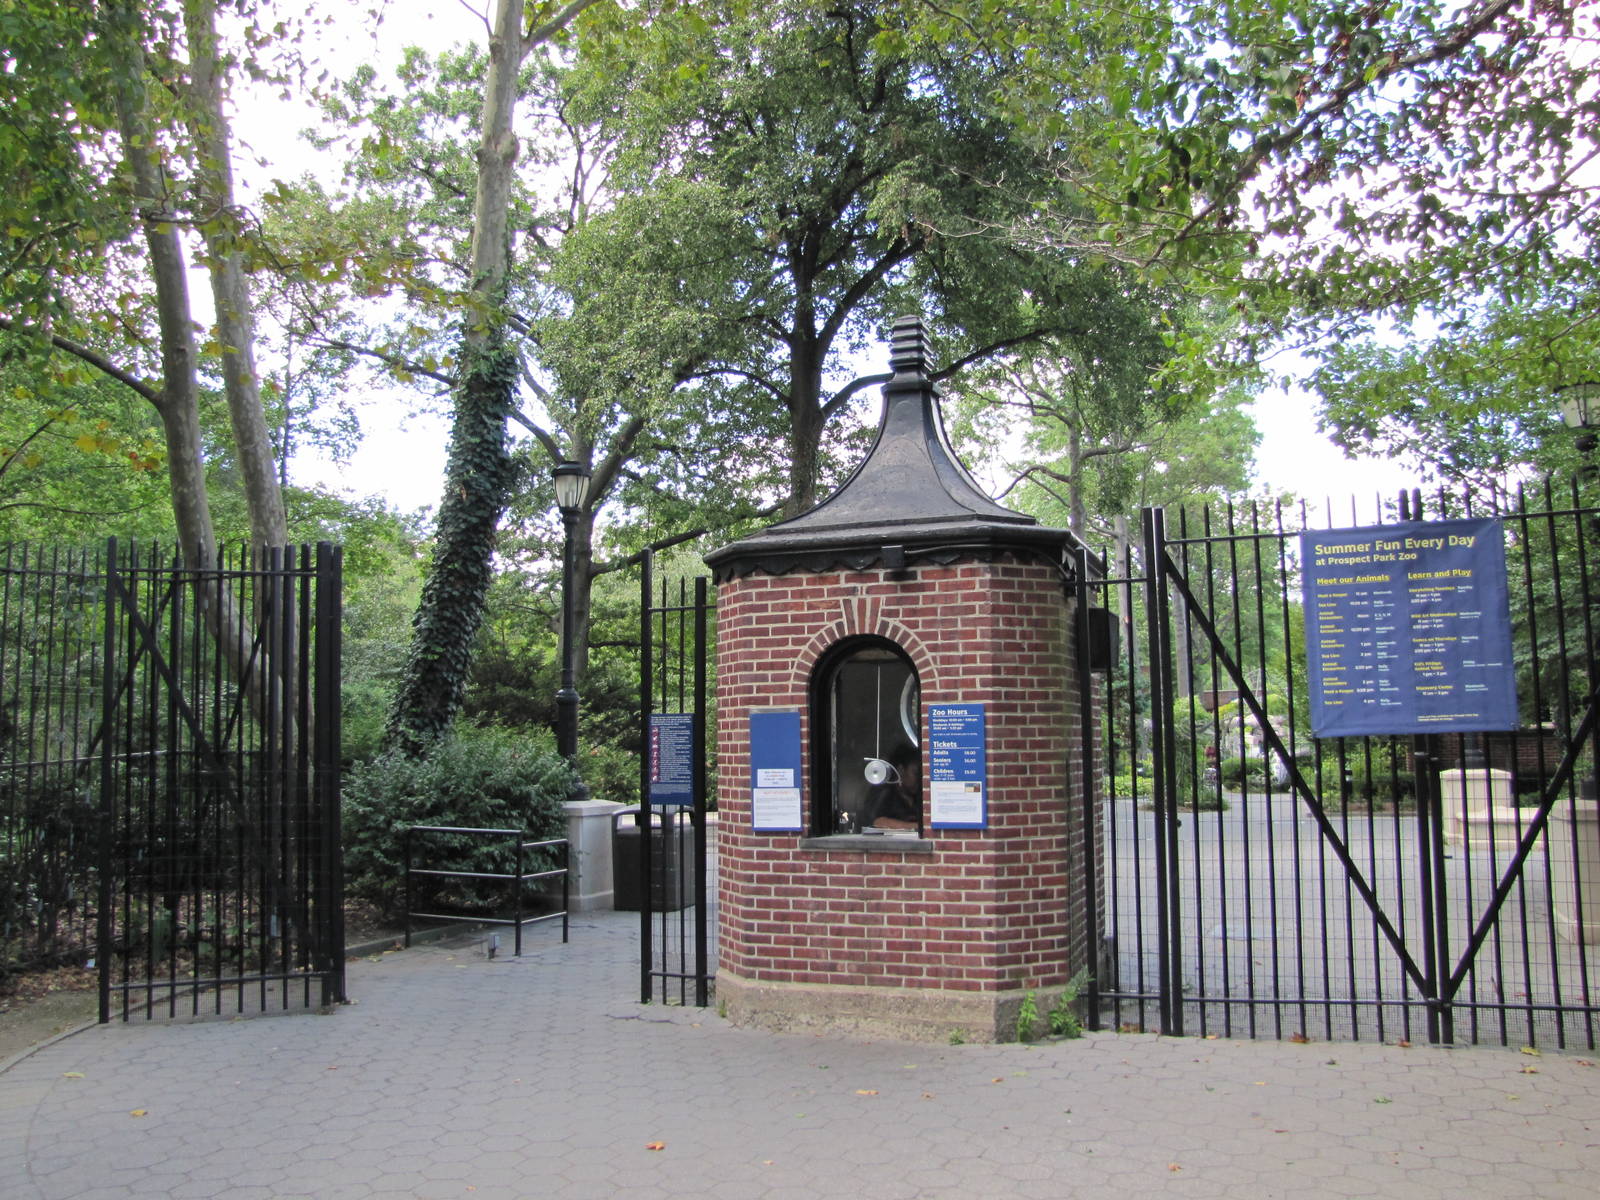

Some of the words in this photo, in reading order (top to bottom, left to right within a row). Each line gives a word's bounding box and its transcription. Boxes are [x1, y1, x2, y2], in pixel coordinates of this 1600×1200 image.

[1315, 544, 1371, 555] Summer
[1375, 540, 1400, 551] Fun
[1405, 538, 1444, 550] Every
[1448, 535, 1475, 548] Day
[1328, 555, 1370, 565] Prospect
[1373, 553, 1396, 562] Park
[1452, 569, 1472, 577] Play
[1356, 574, 1390, 583] Animals
